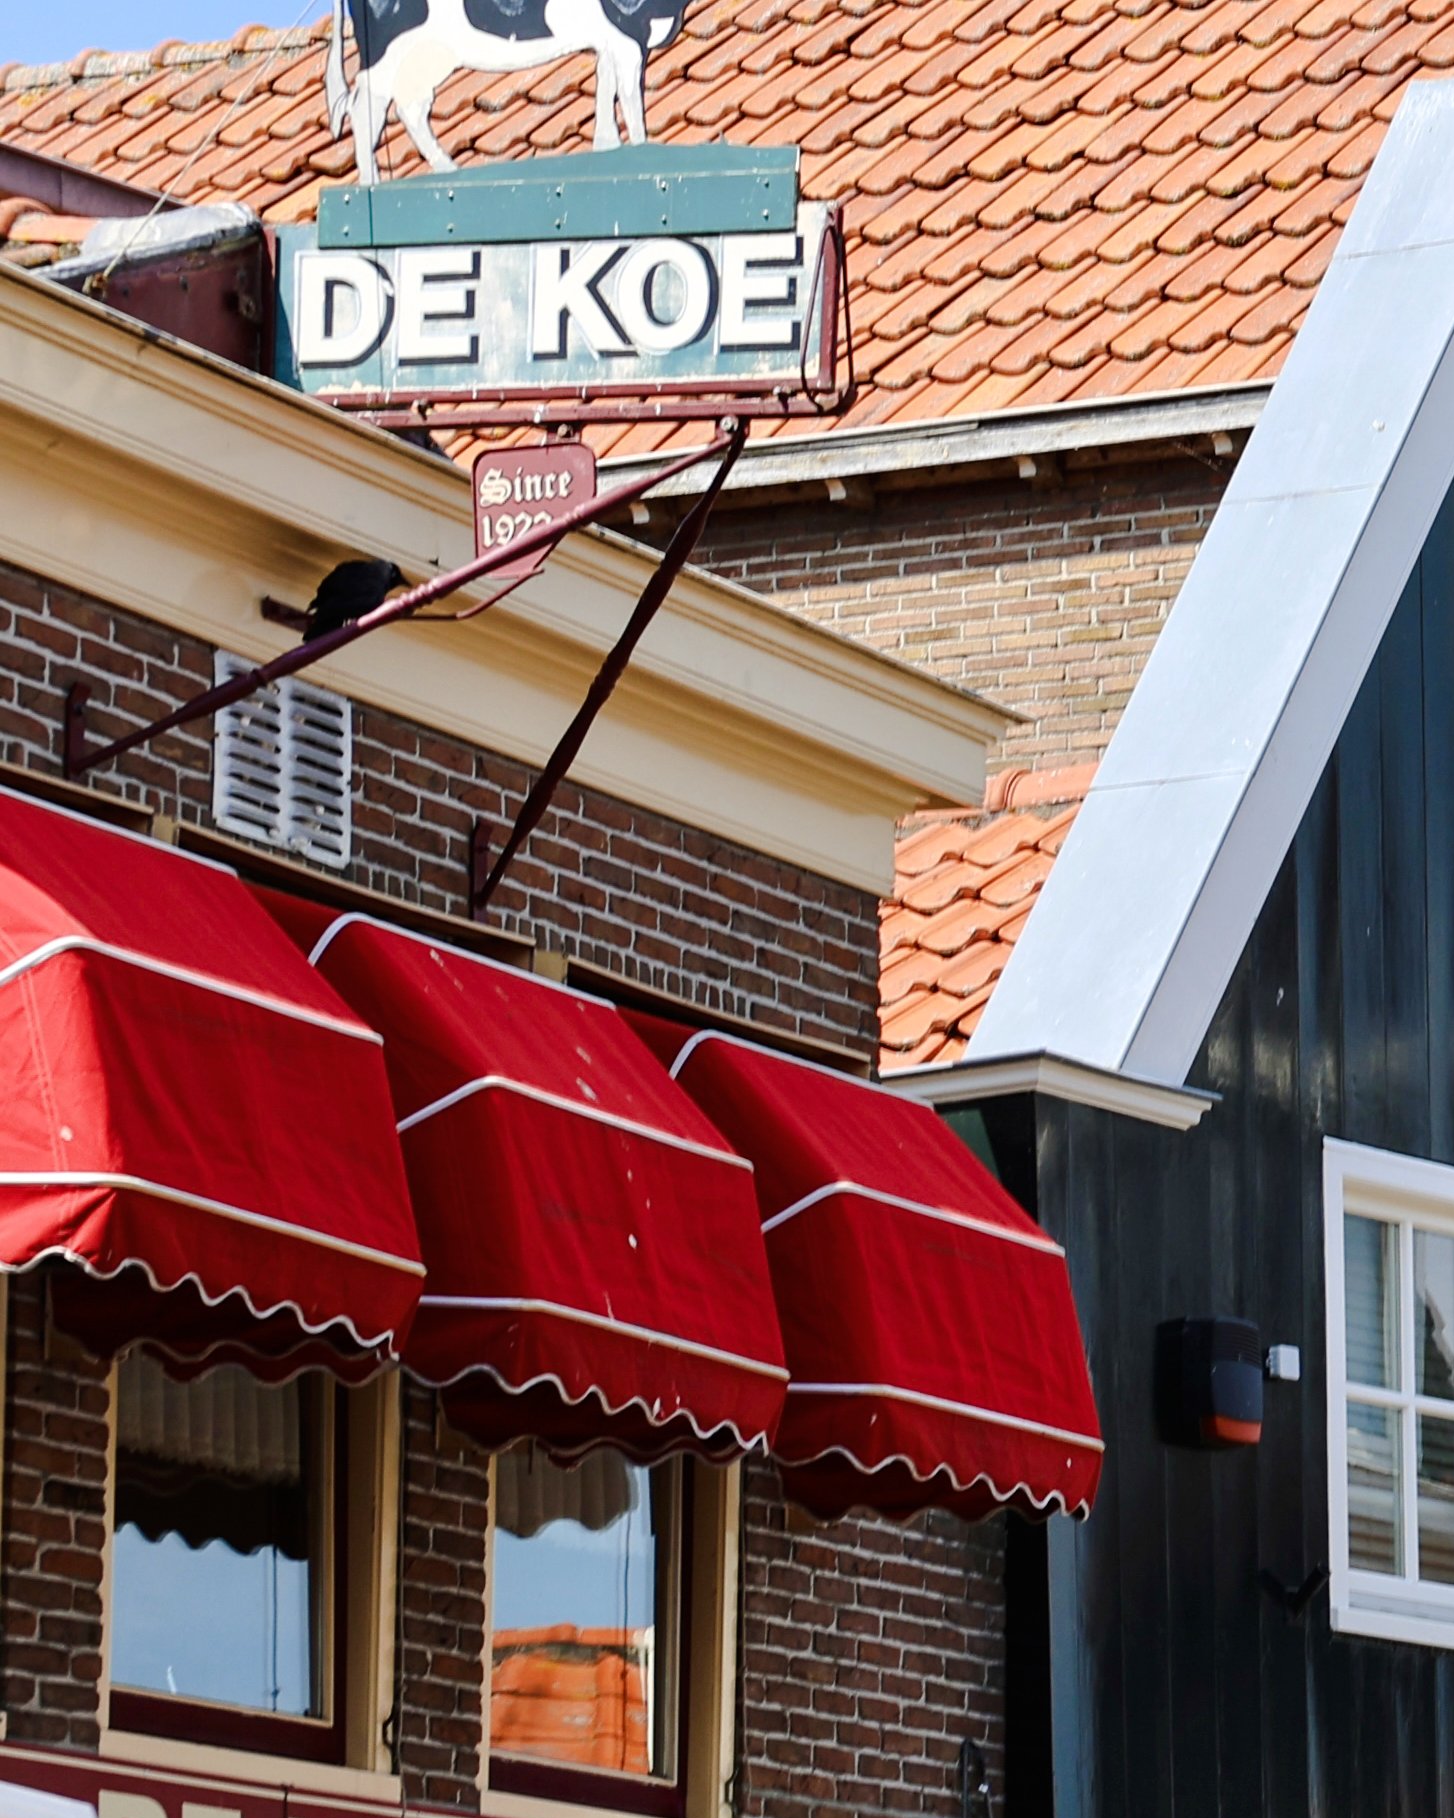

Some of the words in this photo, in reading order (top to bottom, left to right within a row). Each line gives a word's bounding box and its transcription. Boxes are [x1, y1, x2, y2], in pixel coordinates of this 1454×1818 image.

[298, 248, 481, 367] DE
[529, 233, 802, 361] KOE
[479, 467, 573, 507] Since
